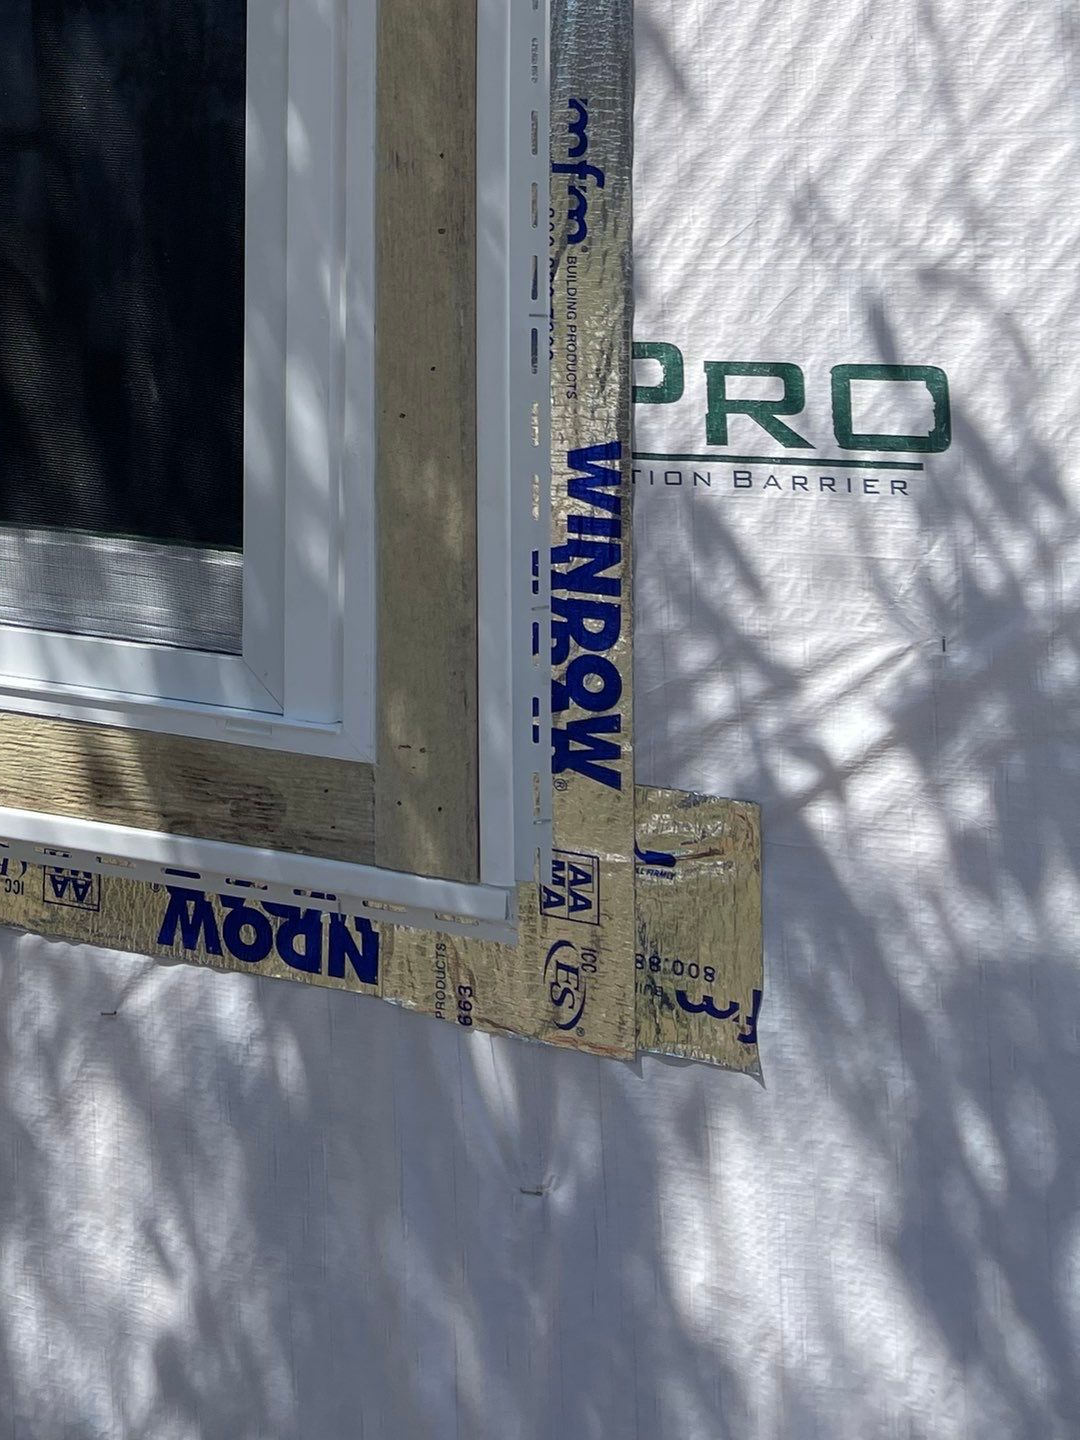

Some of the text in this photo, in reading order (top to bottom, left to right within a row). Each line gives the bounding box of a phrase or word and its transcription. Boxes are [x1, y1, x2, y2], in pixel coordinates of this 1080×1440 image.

[566, 255, 577, 401] BUILDING PRODUCTS
[566, 440, 622, 791] WINDOW
[435, 942, 447, 1020] PRODUCTS
[457, 985, 473, 1027] 663
